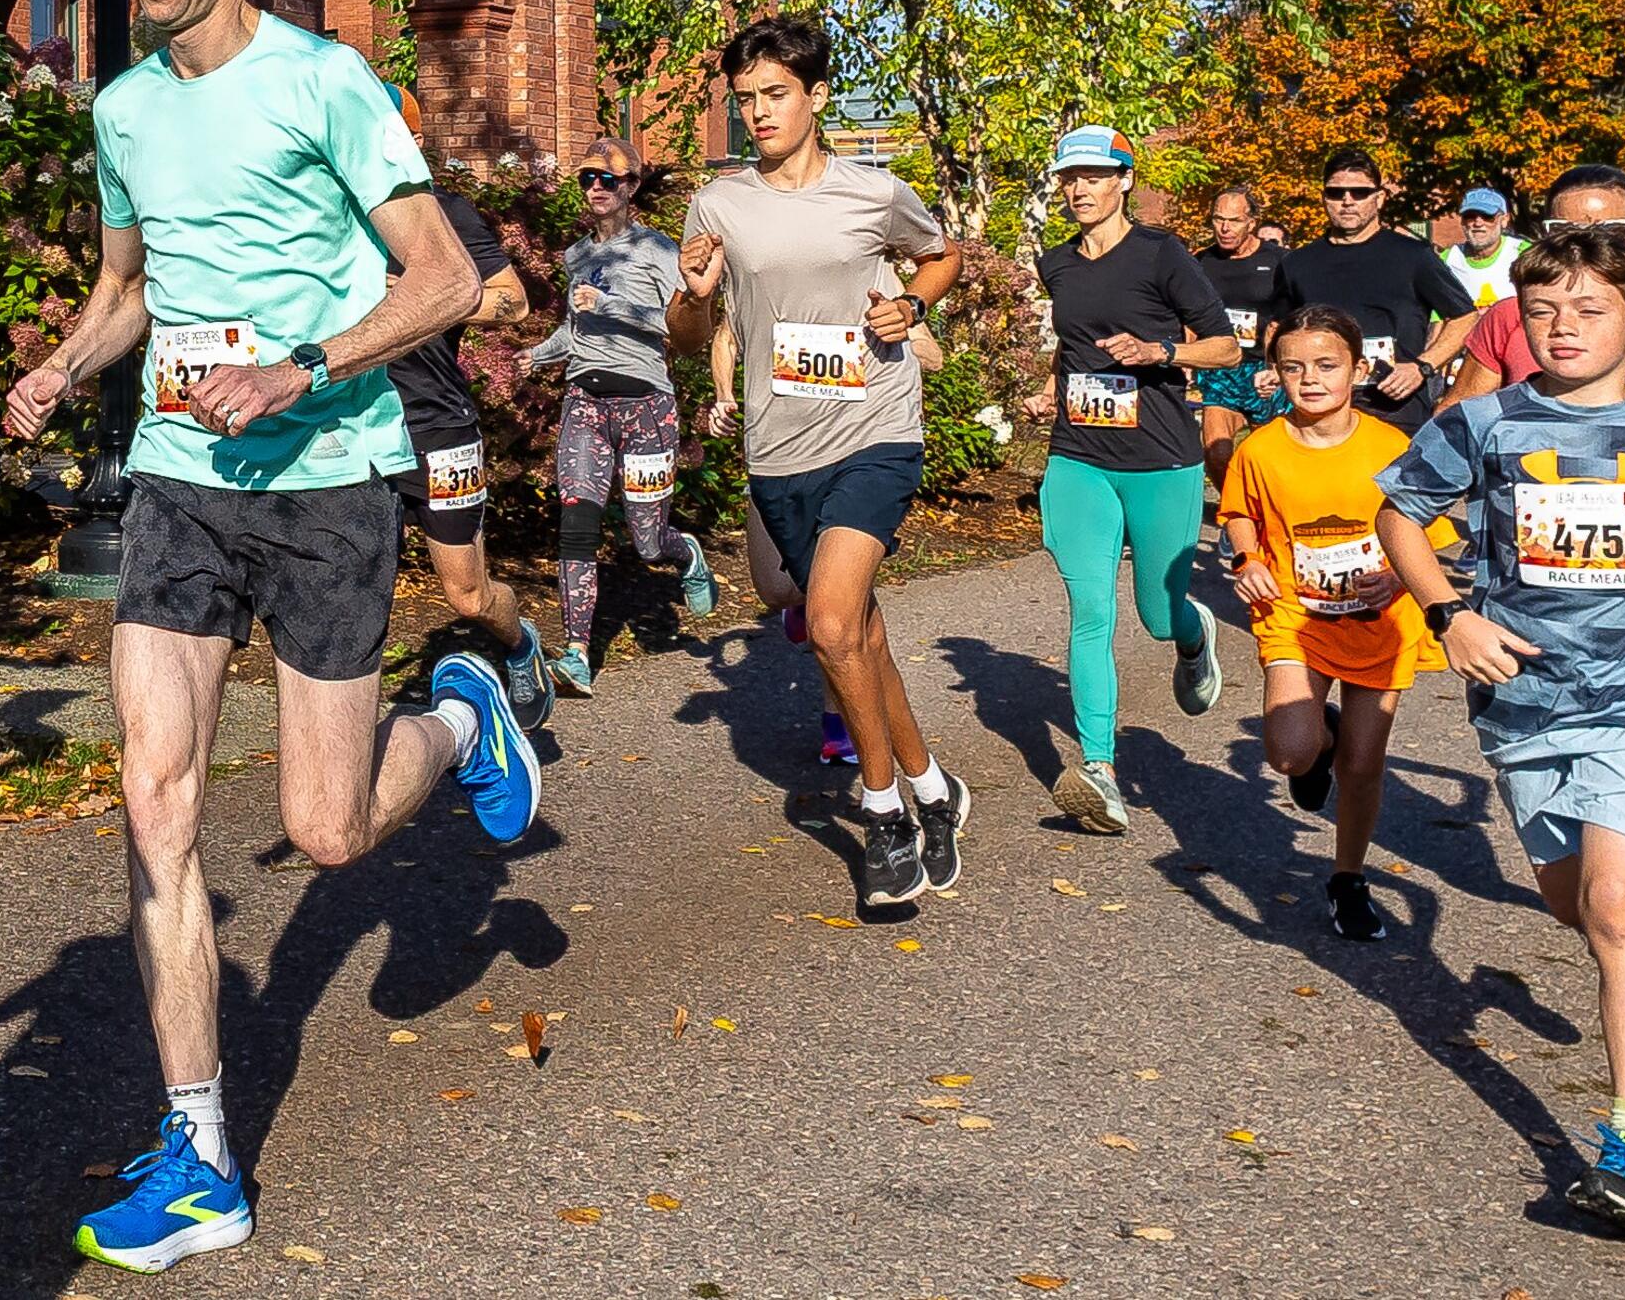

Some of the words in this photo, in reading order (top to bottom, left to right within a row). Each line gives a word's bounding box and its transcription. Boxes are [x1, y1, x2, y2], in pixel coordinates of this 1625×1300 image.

[797, 351, 844, 379] 500
[175, 363, 221, 401] 37
[793, 384, 817, 395] RACE
[1081, 392, 1116, 418] 419
[448, 465, 480, 492] 378
[637, 469, 666, 488] 449
[1552, 523, 1624, 559] 475
[1548, 571, 1587, 584] RACE
